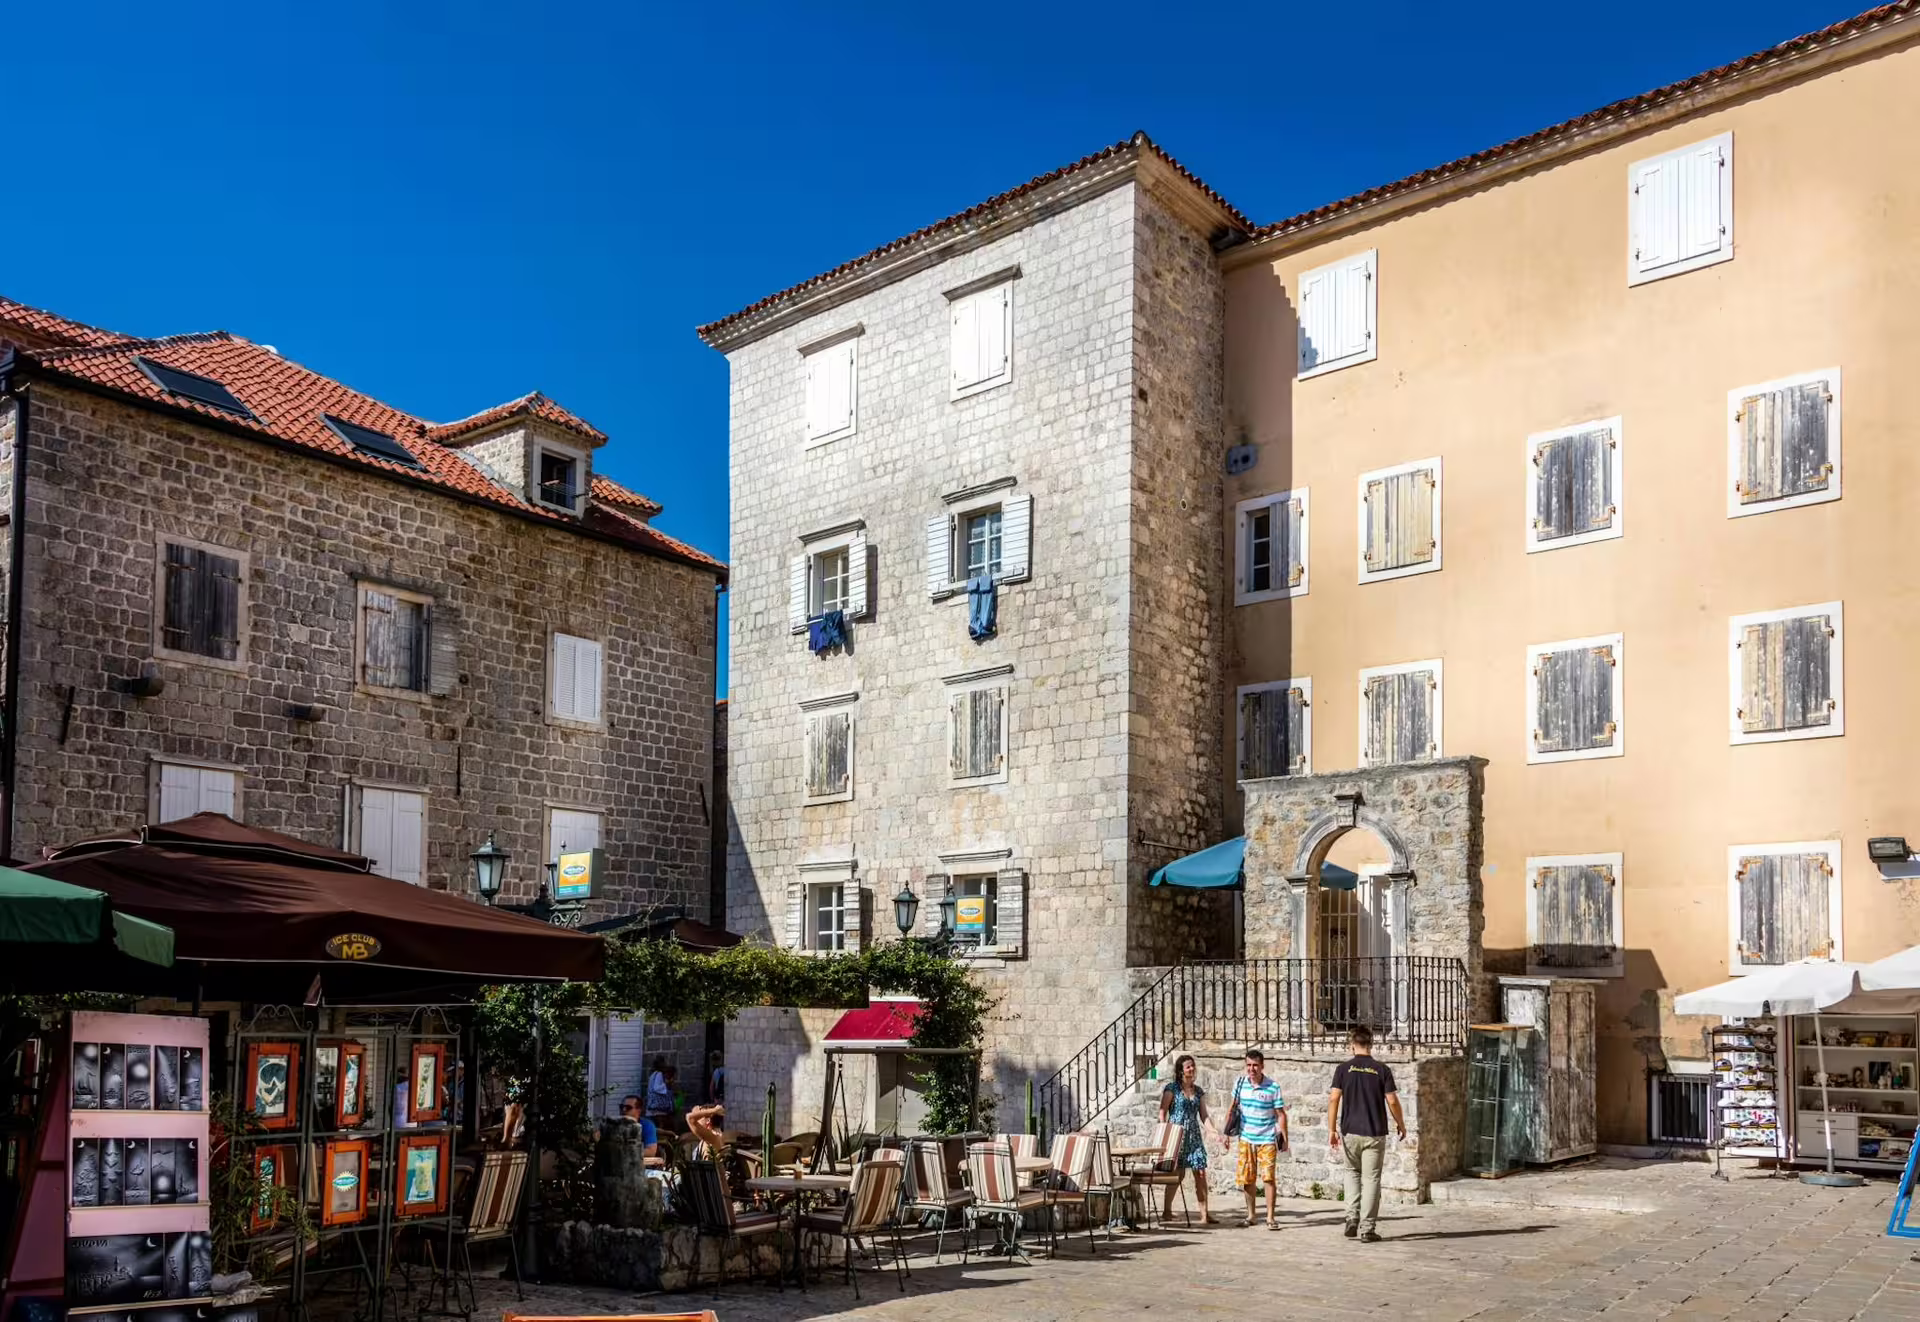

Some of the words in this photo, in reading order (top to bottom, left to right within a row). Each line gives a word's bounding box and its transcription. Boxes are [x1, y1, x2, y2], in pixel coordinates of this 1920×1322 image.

[332, 934, 349, 945] ICE
[351, 934, 375, 946] CLUB
[342, 943, 369, 959] MB
